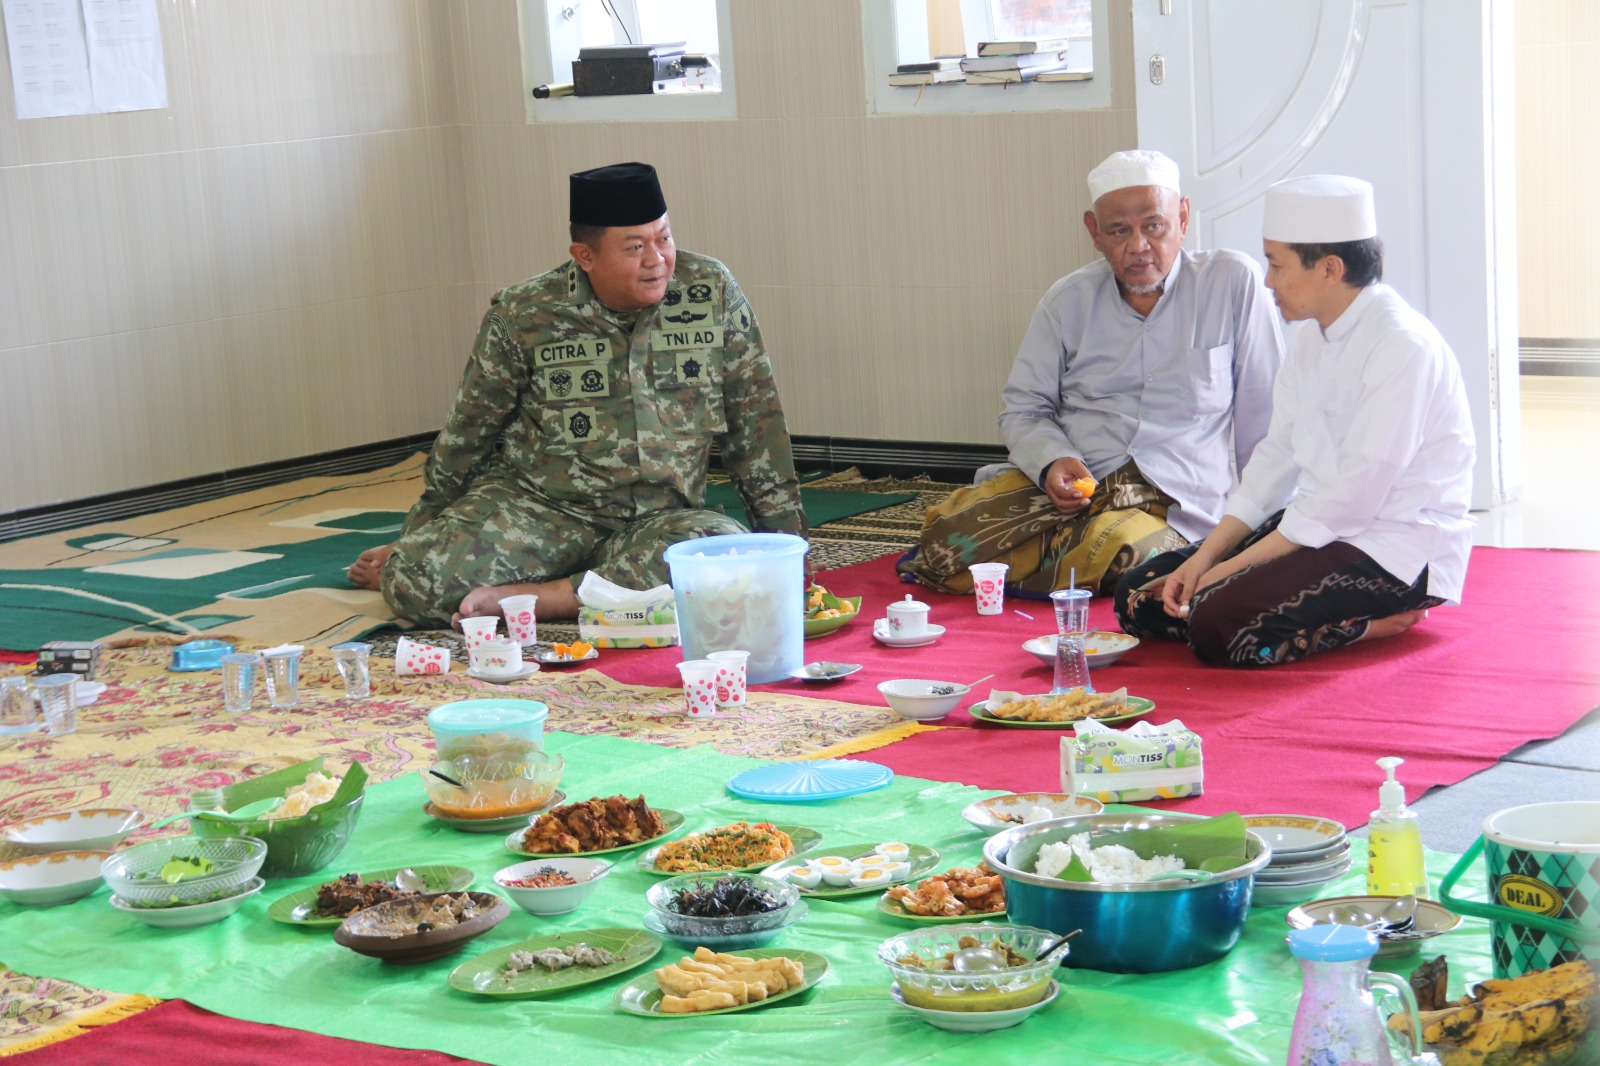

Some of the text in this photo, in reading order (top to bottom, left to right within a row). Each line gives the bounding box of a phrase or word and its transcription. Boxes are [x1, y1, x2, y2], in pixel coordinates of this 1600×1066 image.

[662, 331, 715, 346] TNI AD
[540, 342, 606, 362] CITRA P
[605, 612, 644, 621] MONTISS
[1113, 753, 1163, 765] MONTISS
[1506, 887, 1546, 908] DEAL
